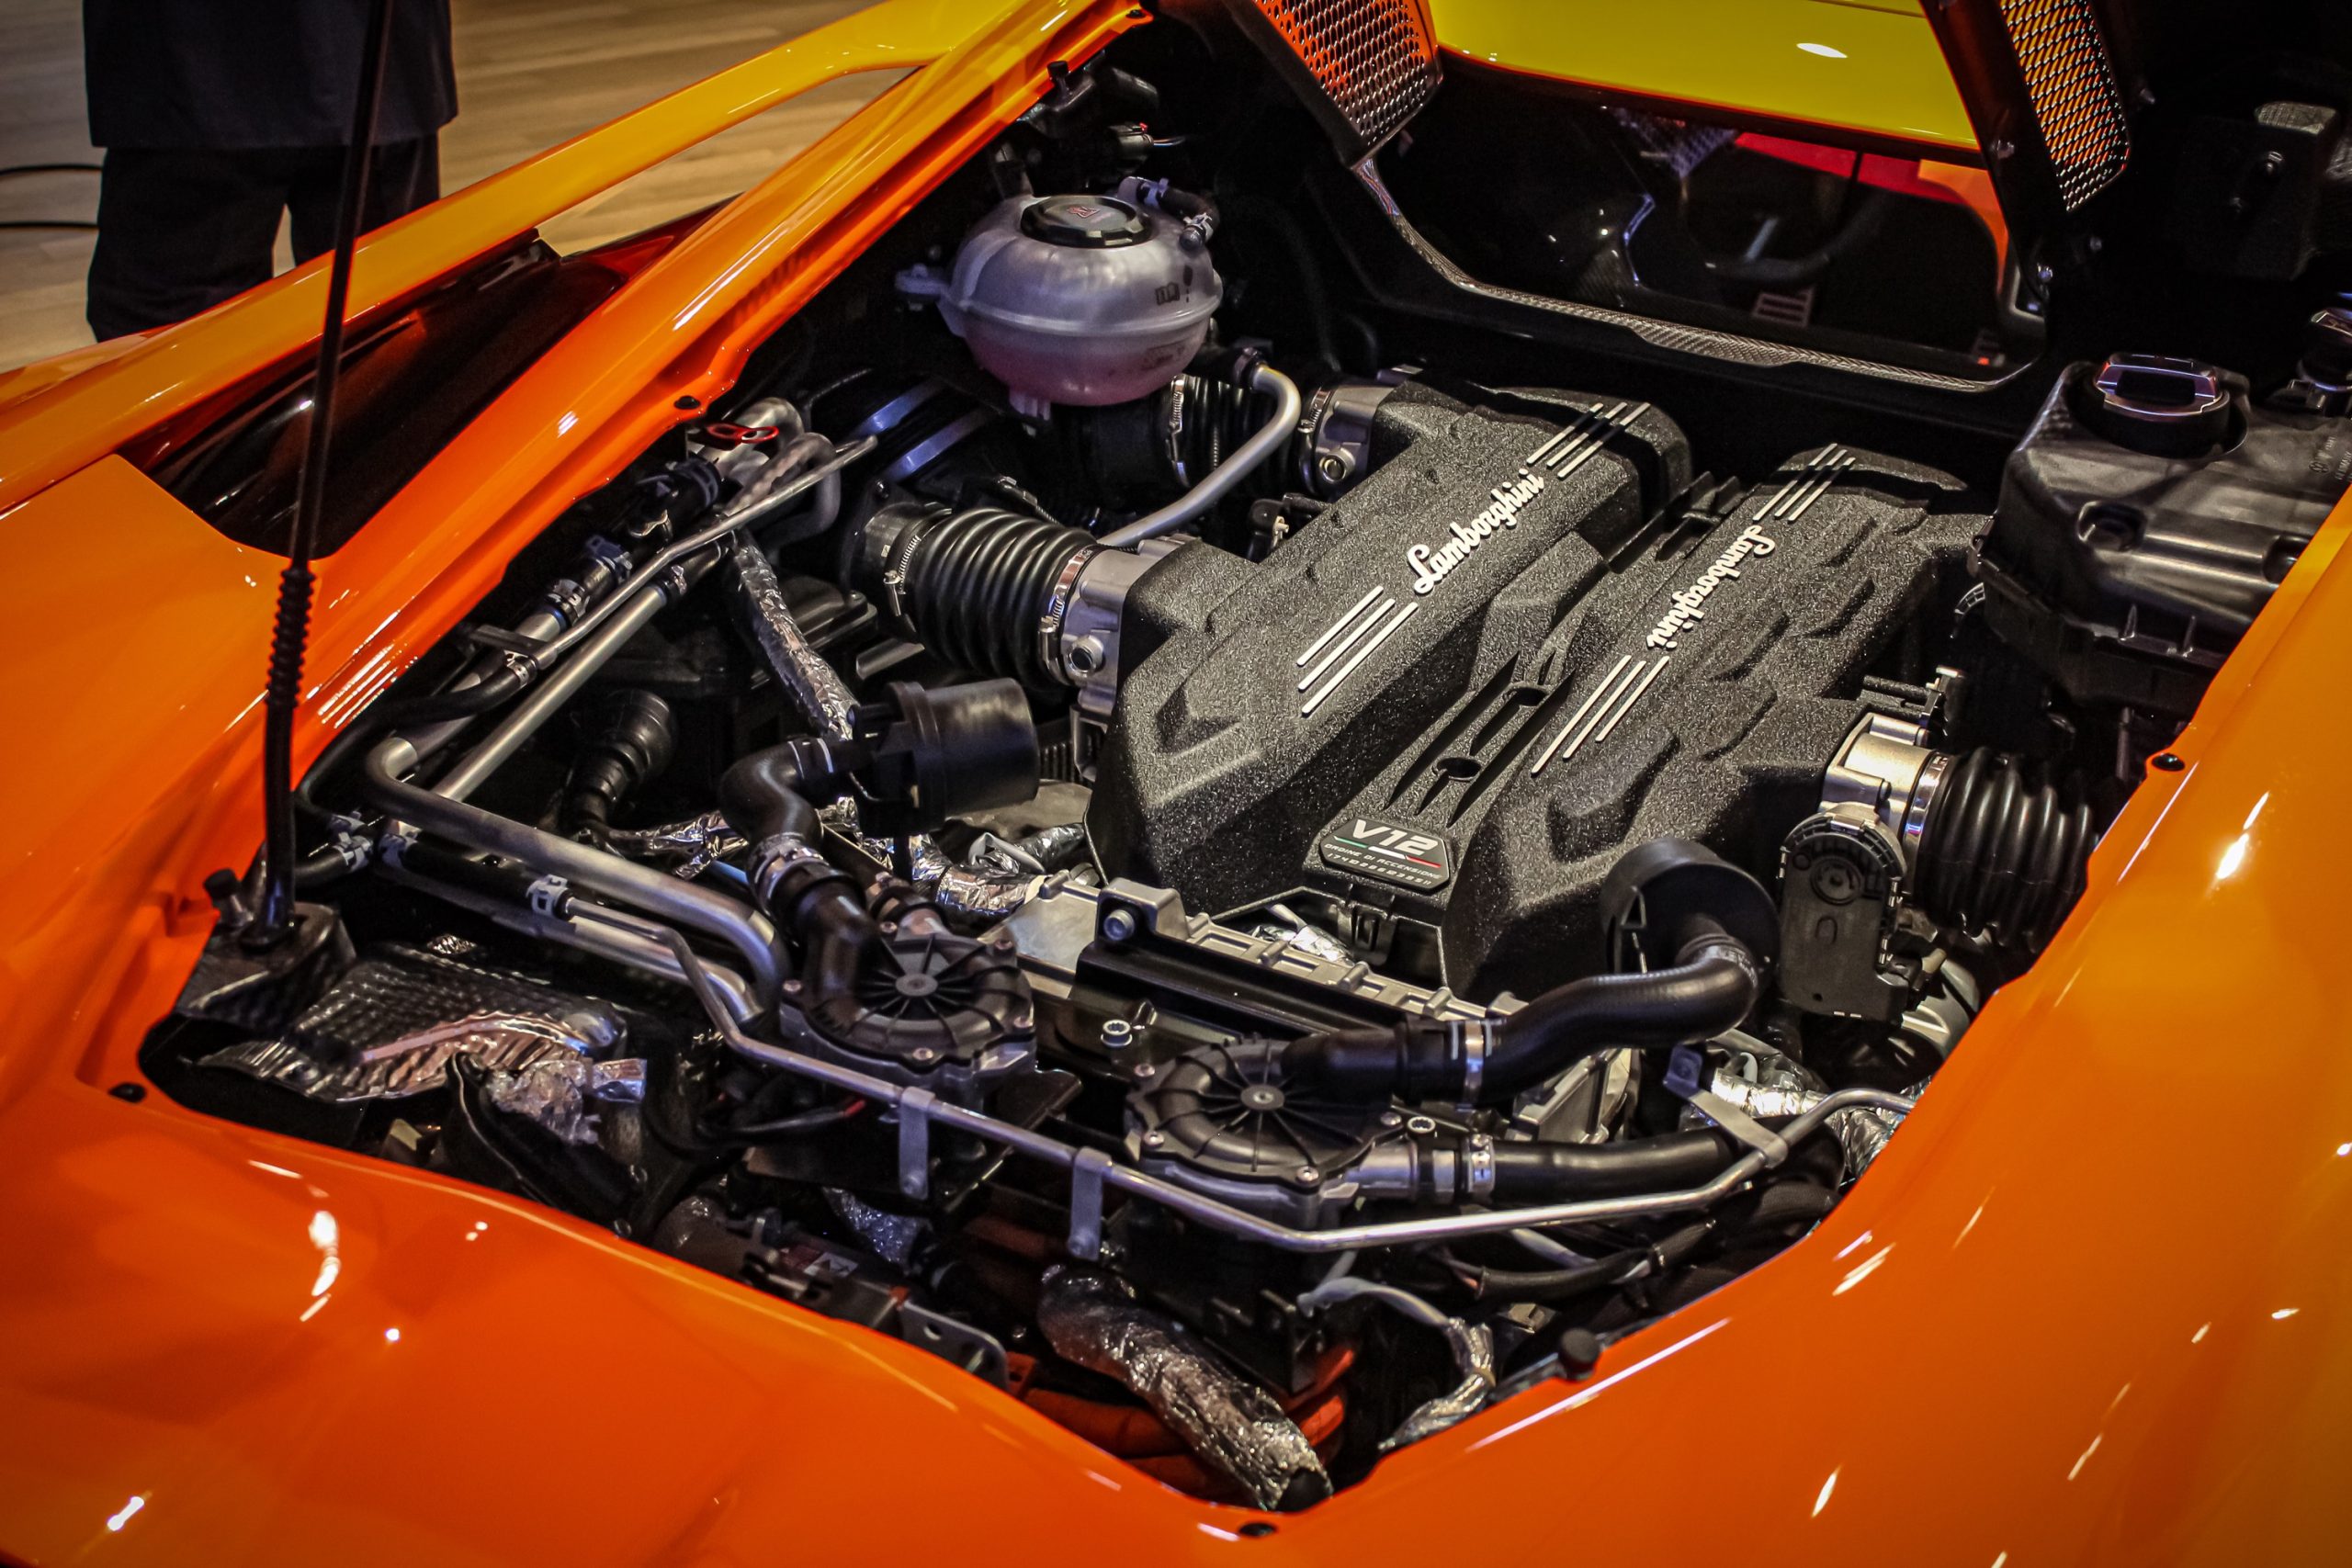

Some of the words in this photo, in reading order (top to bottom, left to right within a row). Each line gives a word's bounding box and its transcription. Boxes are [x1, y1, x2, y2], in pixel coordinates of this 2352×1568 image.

[1407, 468, 1544, 593] Lamborghini
[1646, 525, 1776, 649] Lamborghini
[1324, 843, 1363, 857] ORDINE
[1377, 859, 1442, 879] ACCENSIONE
[1352, 819, 1439, 855] V12
